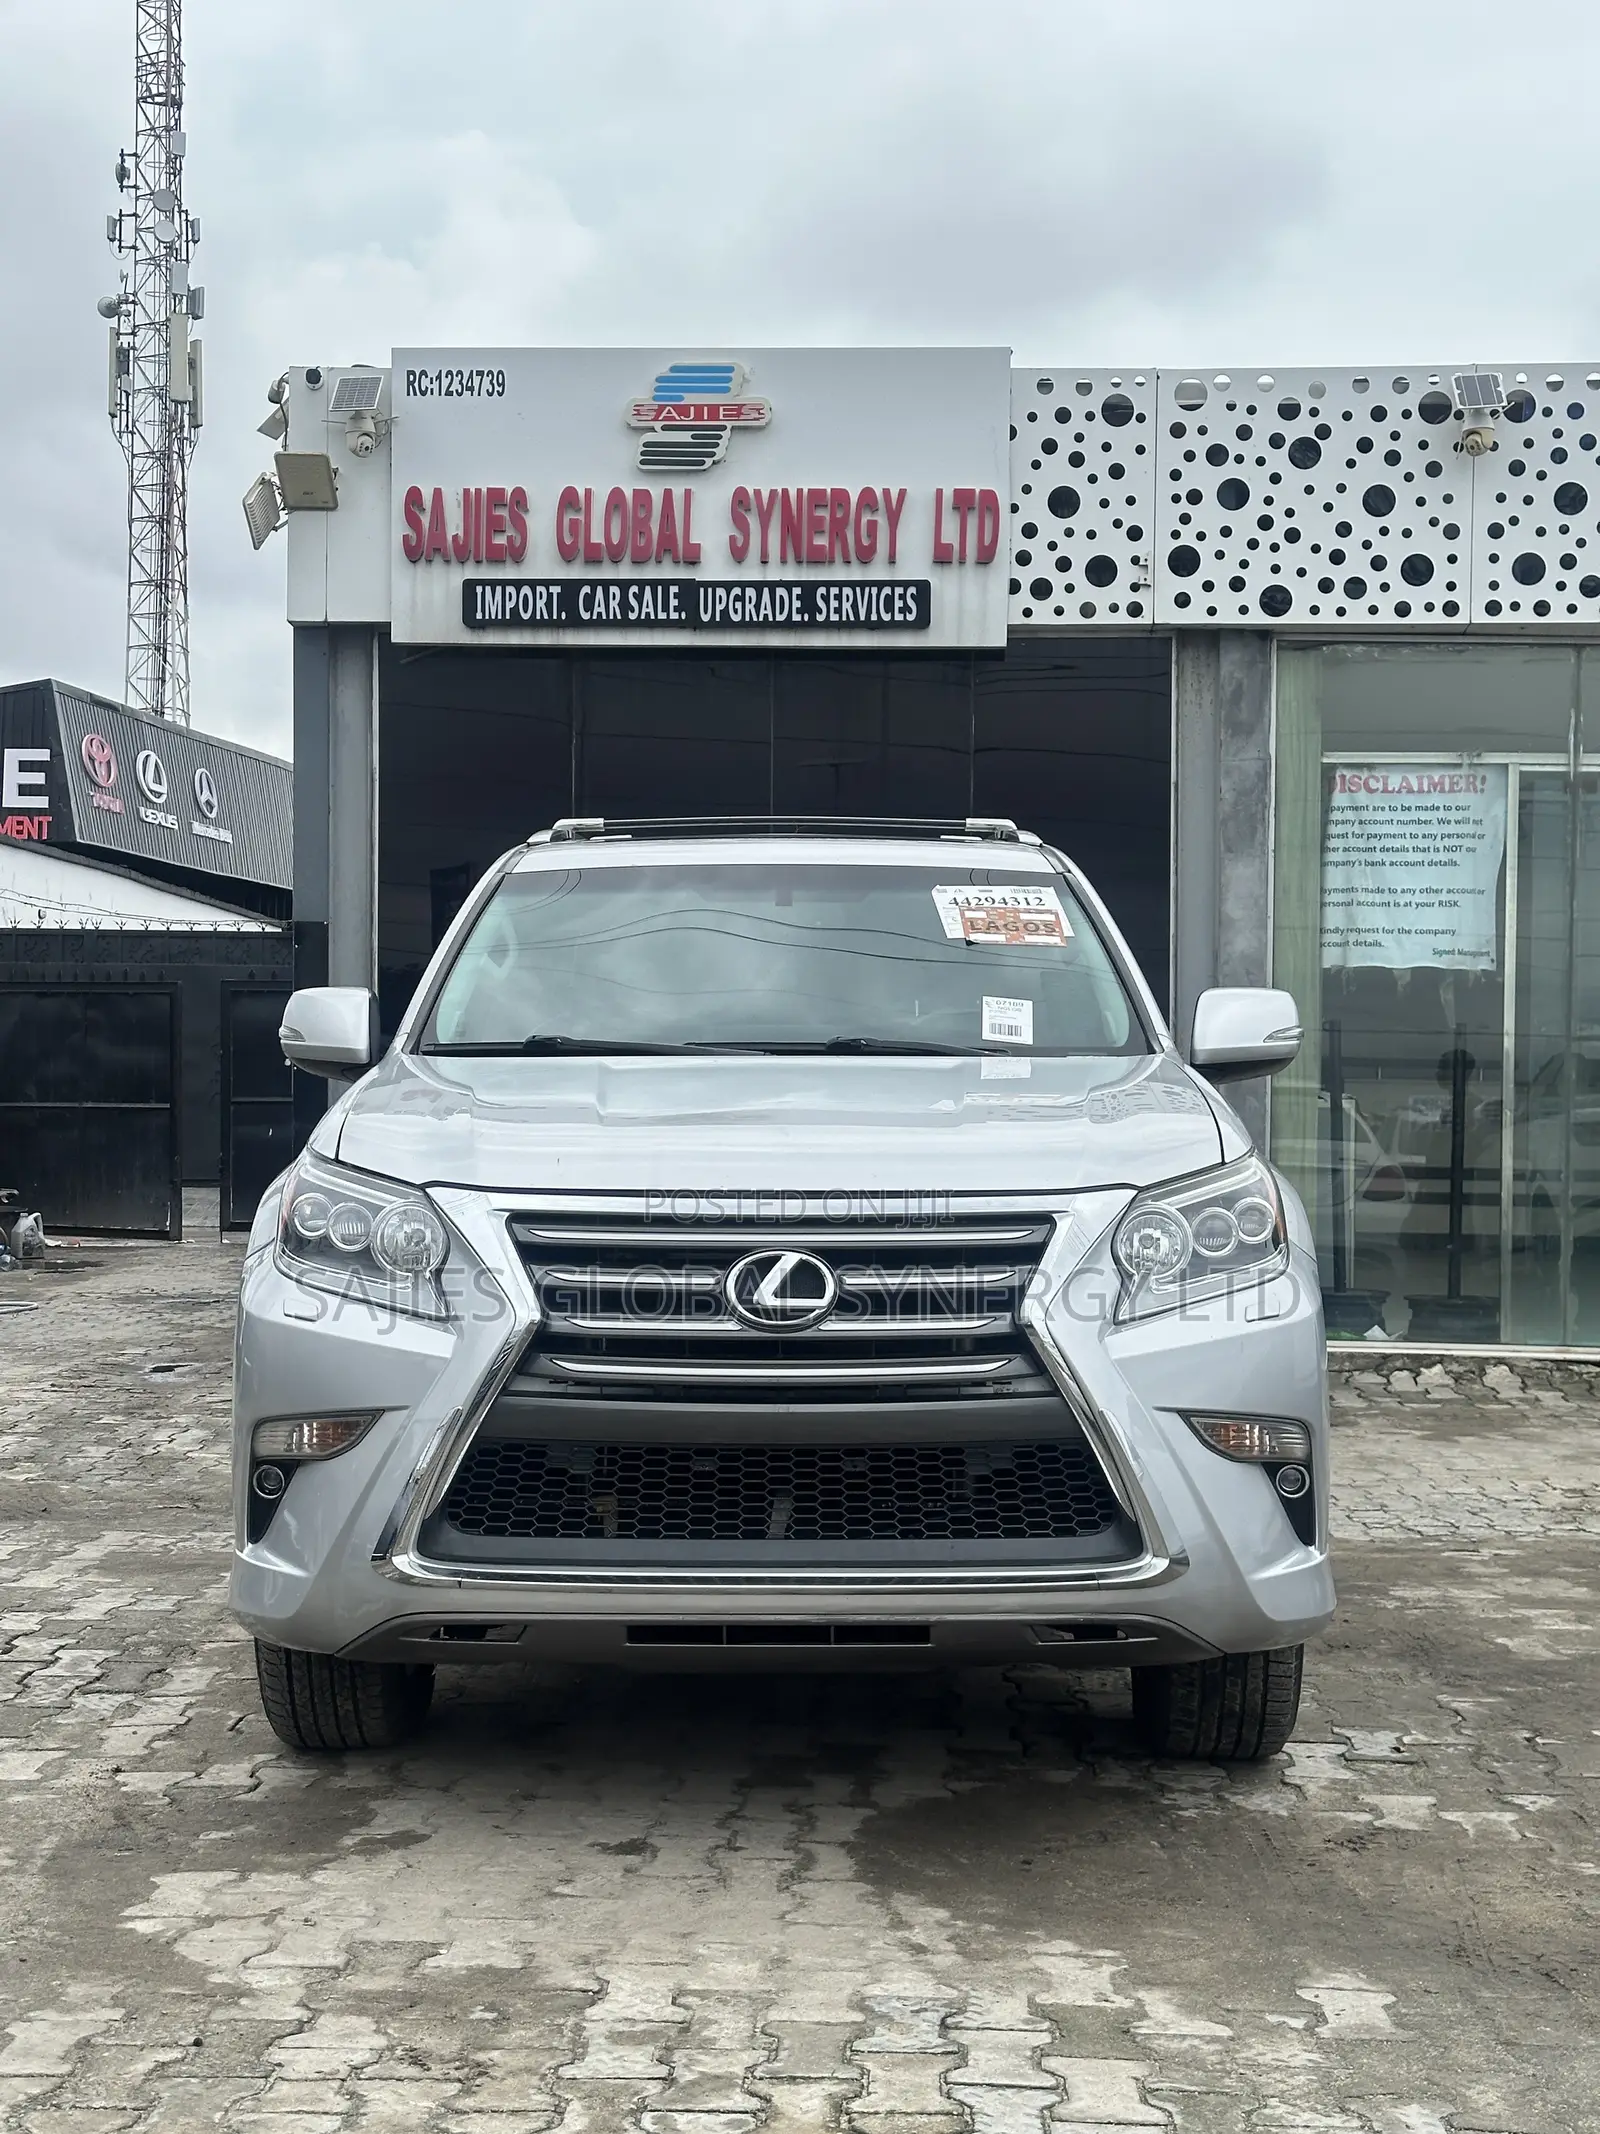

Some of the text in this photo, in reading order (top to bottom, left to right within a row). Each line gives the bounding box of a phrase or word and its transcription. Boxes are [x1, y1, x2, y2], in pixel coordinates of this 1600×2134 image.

[406, 369, 506, 397] RC:1234739
[632, 404, 766, 421] SAJIES
[402, 485, 1001, 564] SAJIES GLOBAL SYNERGY LTD
[475, 584, 918, 624] IMPORT. CAR SALE. UPGRADE. SERVICES
[1330, 804, 1369, 814] payment
[1388, 804, 1398, 812] to
[1401, 804, 1412, 812] be
[1415, 804, 1441, 812] made
[1443, 804, 1453, 812] to
[1455, 804, 1471, 812] our
[139, 806, 178, 829] LEXUS
[1358, 818, 1394, 826] account
[1396, 817, 1434, 825] number.
[1437, 817, 1452, 825] We
[1454, 817, 1470, 825] will
[1352, 831, 1365, 839] for
[1367, 832, 1407, 841] payment
[1421, 833, 1438, 841] any
[1342, 845, 1377, 853] account
[1379, 845, 1410, 853] details
[1412, 845, 1431, 853] that
[1433, 845, 1440, 853] is
[1364, 858, 1386, 867] bank
[1427, 858, 1460, 867] details.
[1400, 888, 1417, 896] any
[1419, 886, 1444, 894] other
[949, 896, 1046, 906] 44294312
[1393, 899, 1401, 907] is
[1415, 901, 1435, 910] your
[969, 921, 1057, 933] LAGOS
[1346, 927, 1380, 935] request
[1382, 926, 1395, 934] for
[1397, 926, 1412, 934] the
[1414, 928, 1456, 937] company
[1352, 939, 1384, 947] details.
